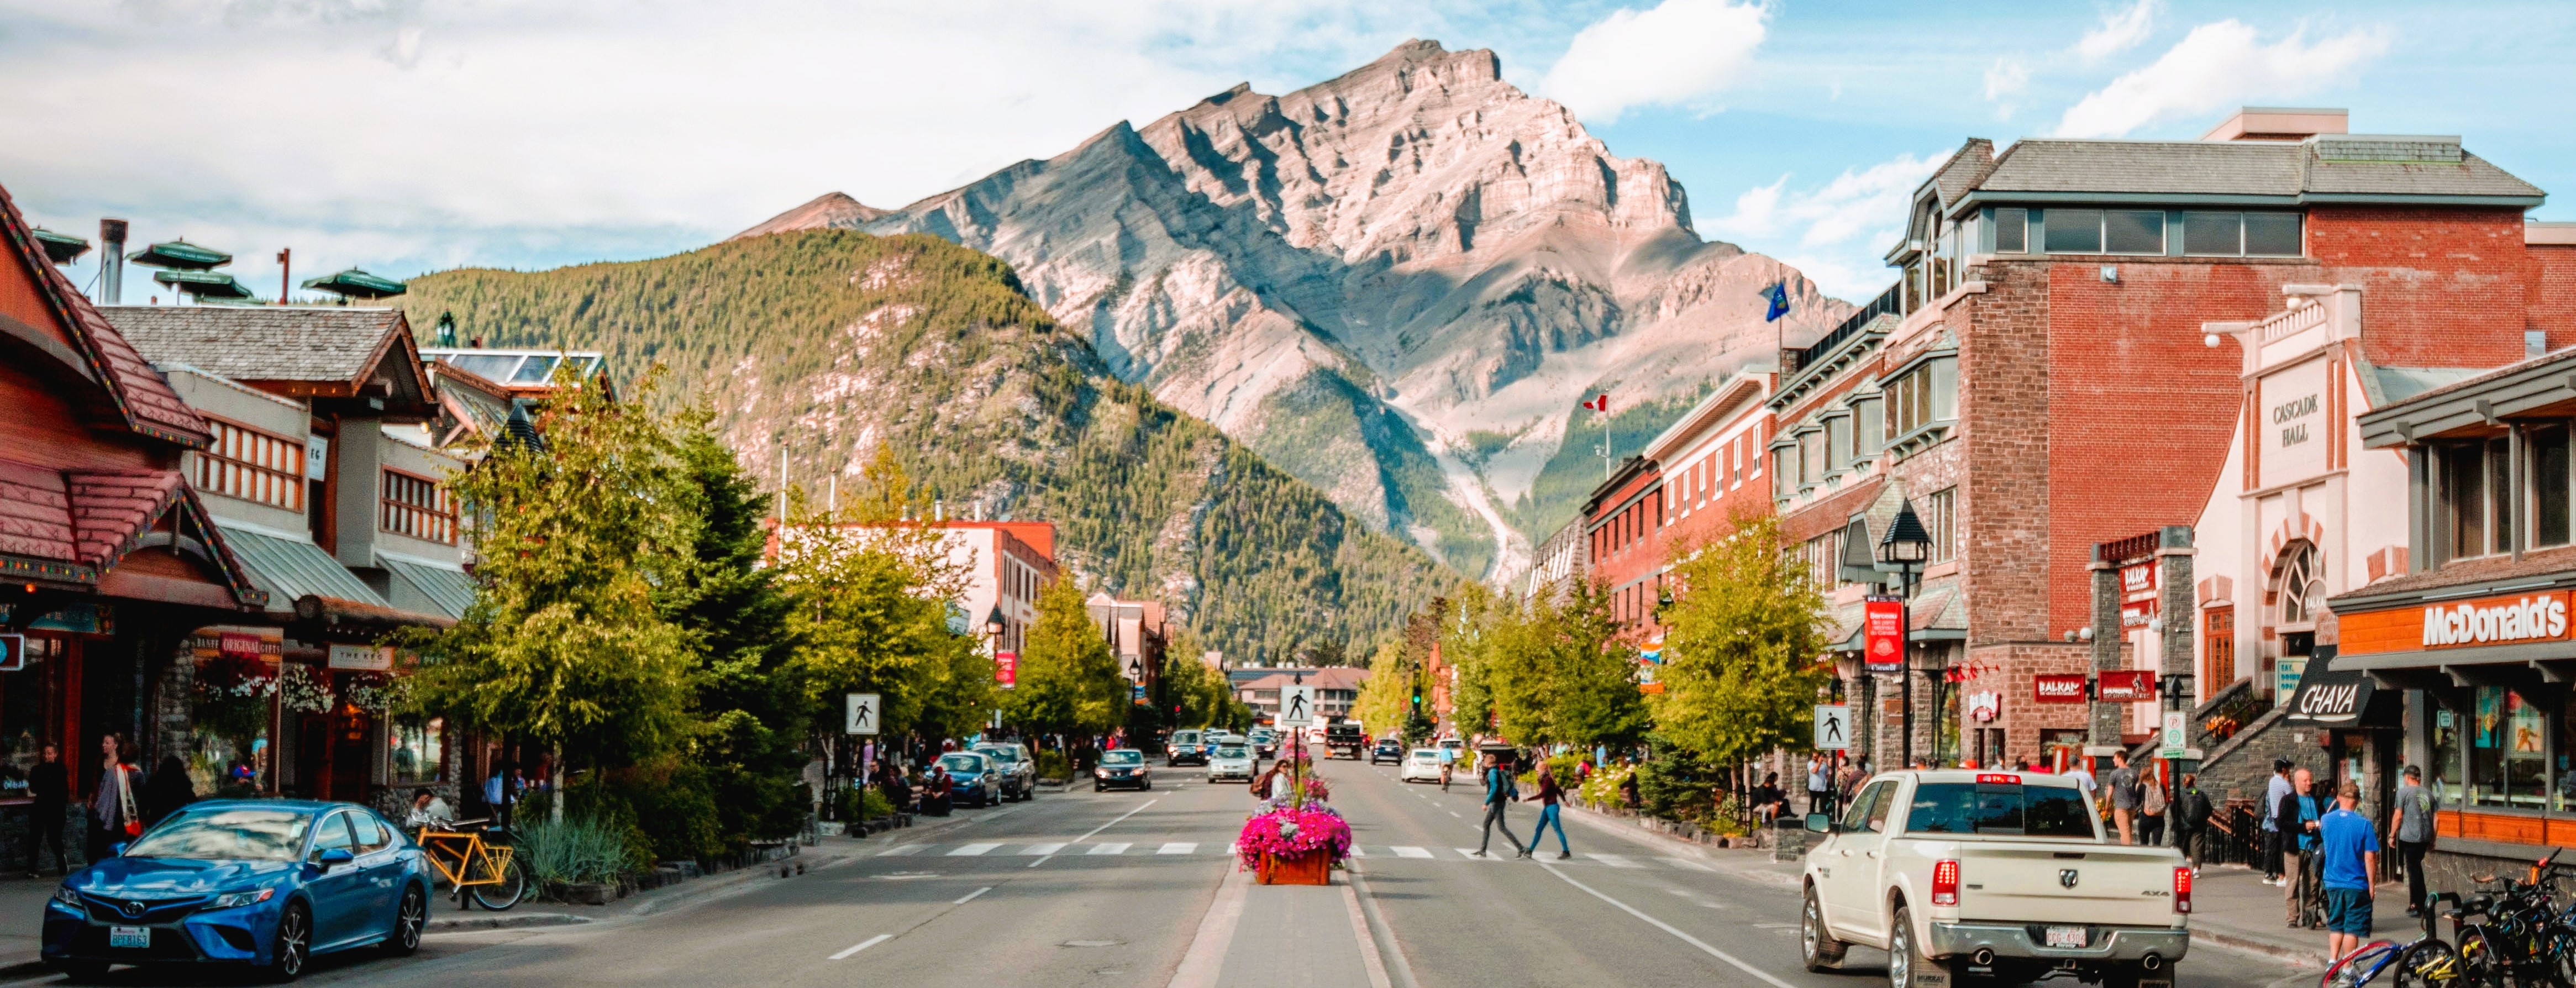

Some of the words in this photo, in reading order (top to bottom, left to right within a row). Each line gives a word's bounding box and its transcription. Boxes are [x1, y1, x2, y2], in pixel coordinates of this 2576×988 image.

[2273, 393, 2317, 425] CASCADE
[2282, 423, 2309, 448] HALL
[2125, 566, 2149, 586] BALKAN
[2423, 596, 2566, 645] McDonald's
[197, 638, 219, 648] BANFF
[223, 638, 260, 654] ORIGINAL
[260, 644, 280, 654] GIFTS
[2039, 680, 2080, 692] BALKAN
[2300, 684, 2358, 714] CHAYA
